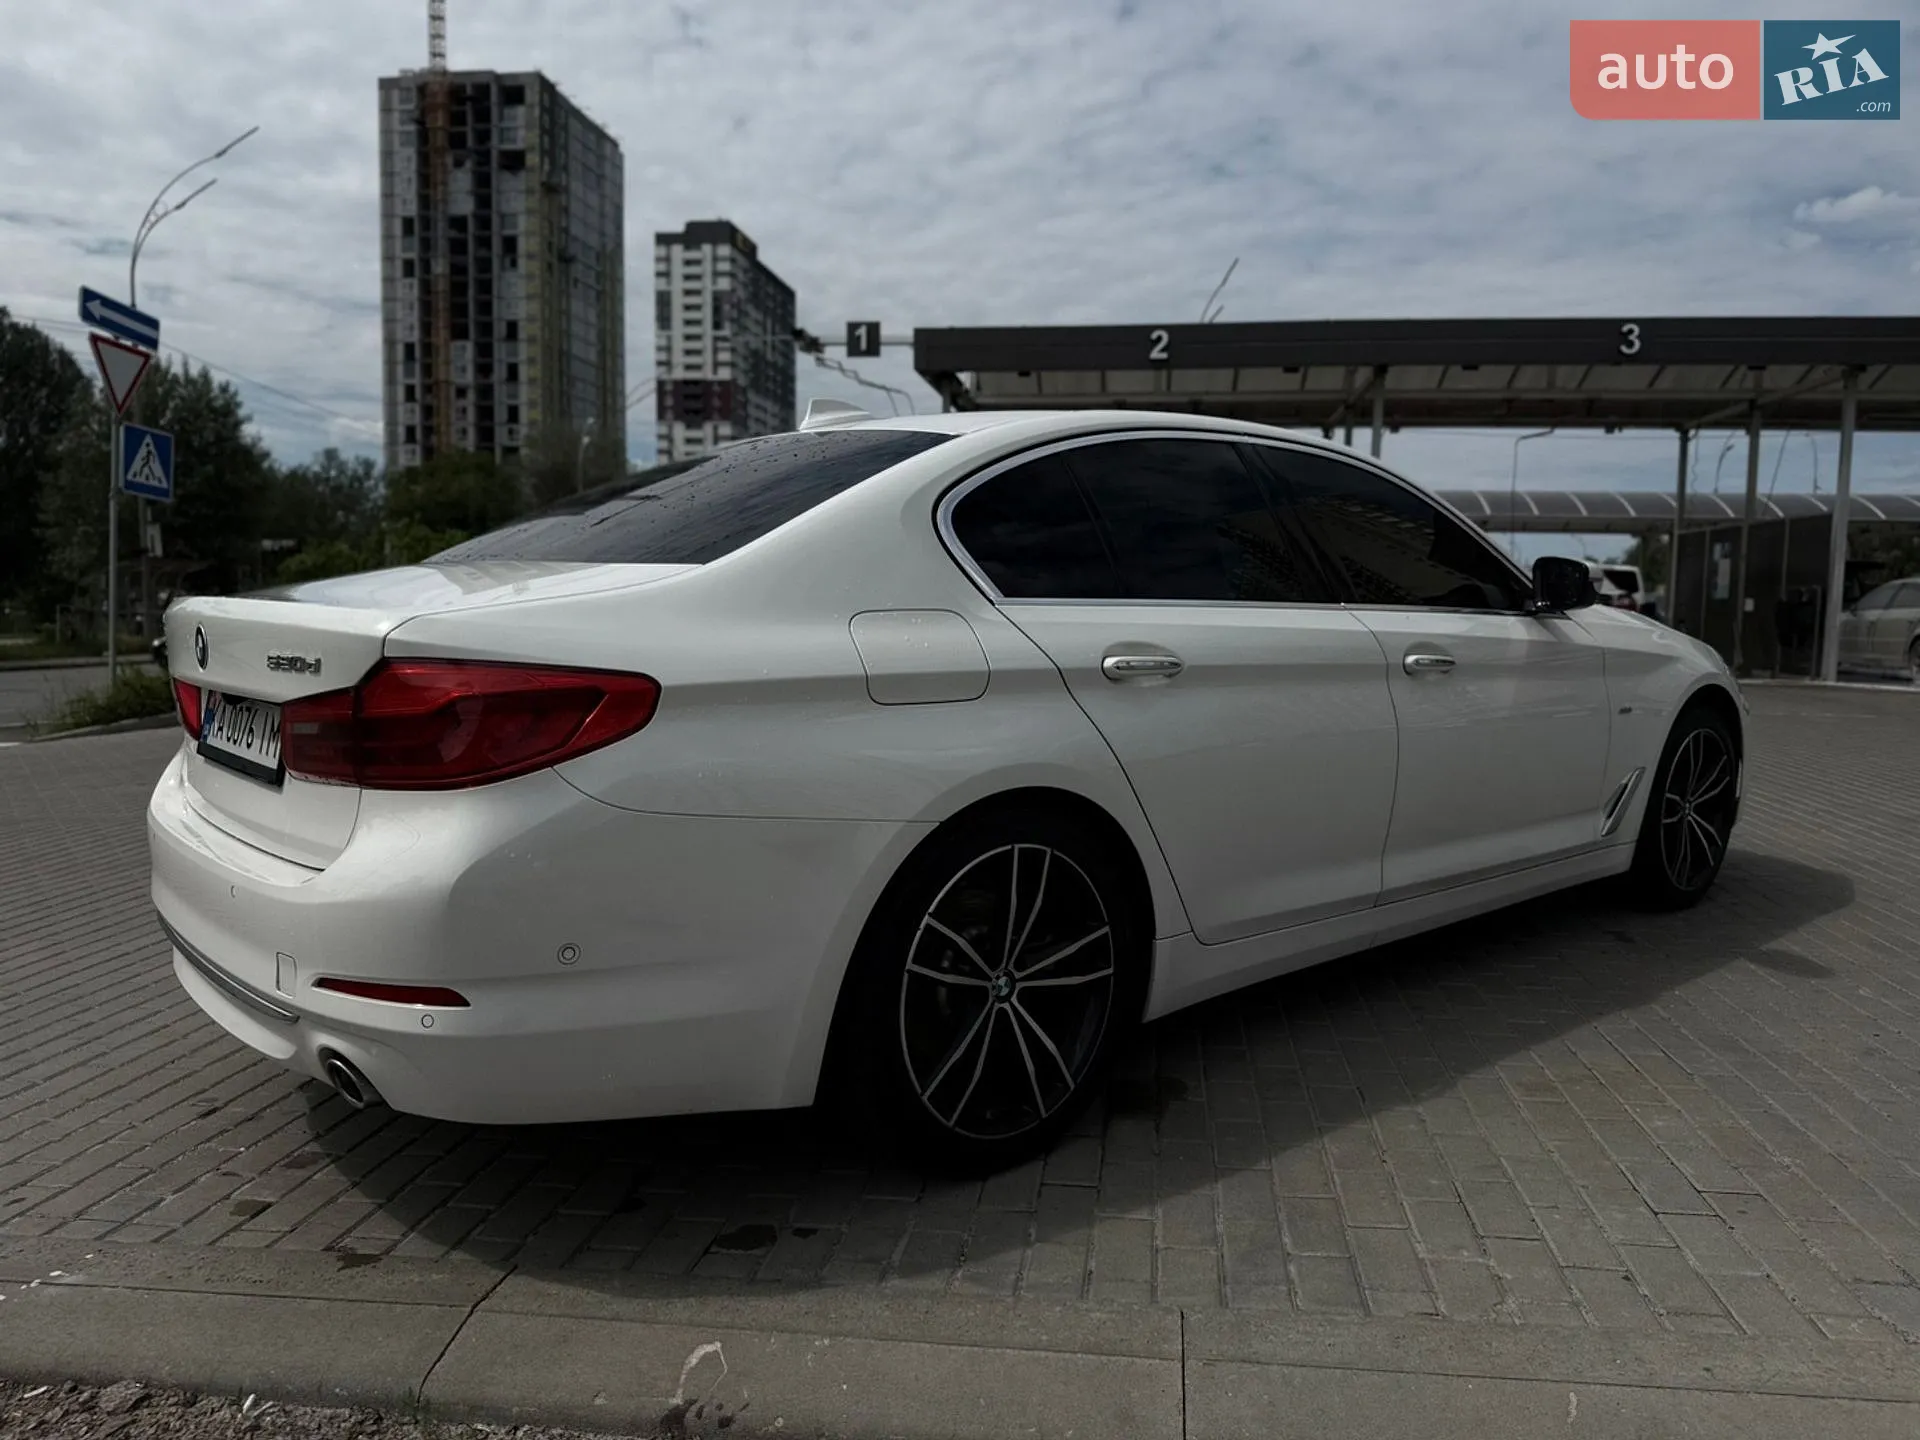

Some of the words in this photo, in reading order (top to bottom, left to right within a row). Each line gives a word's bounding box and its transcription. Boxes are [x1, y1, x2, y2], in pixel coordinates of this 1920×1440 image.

[854, 324, 868, 352] 1
[1150, 329, 1169, 359] 2
[1619, 323, 1642, 354] 3
[226, 704, 260, 749] 0076
